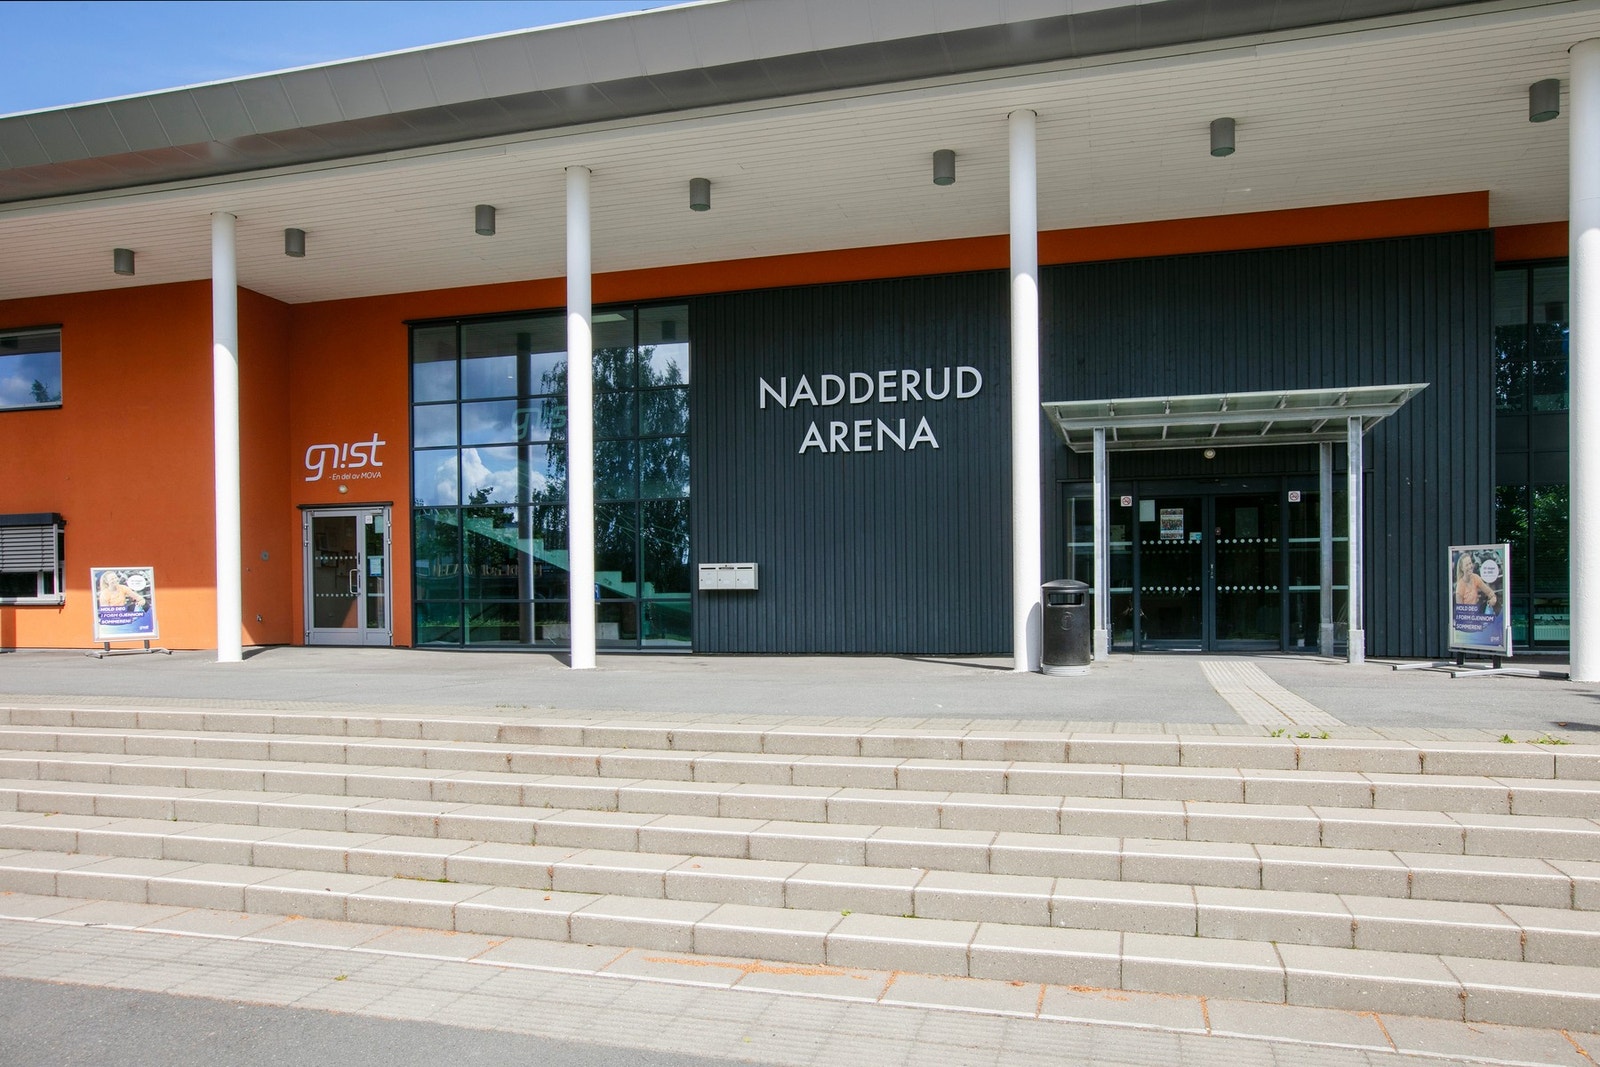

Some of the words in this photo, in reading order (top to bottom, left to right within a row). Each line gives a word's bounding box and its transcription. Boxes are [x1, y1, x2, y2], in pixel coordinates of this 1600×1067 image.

[760, 366, 982, 409] NADDERUD
[798, 415, 940, 454] ARENA
[341, 472, 351, 480] del
[360, 471, 382, 479] MOVA
